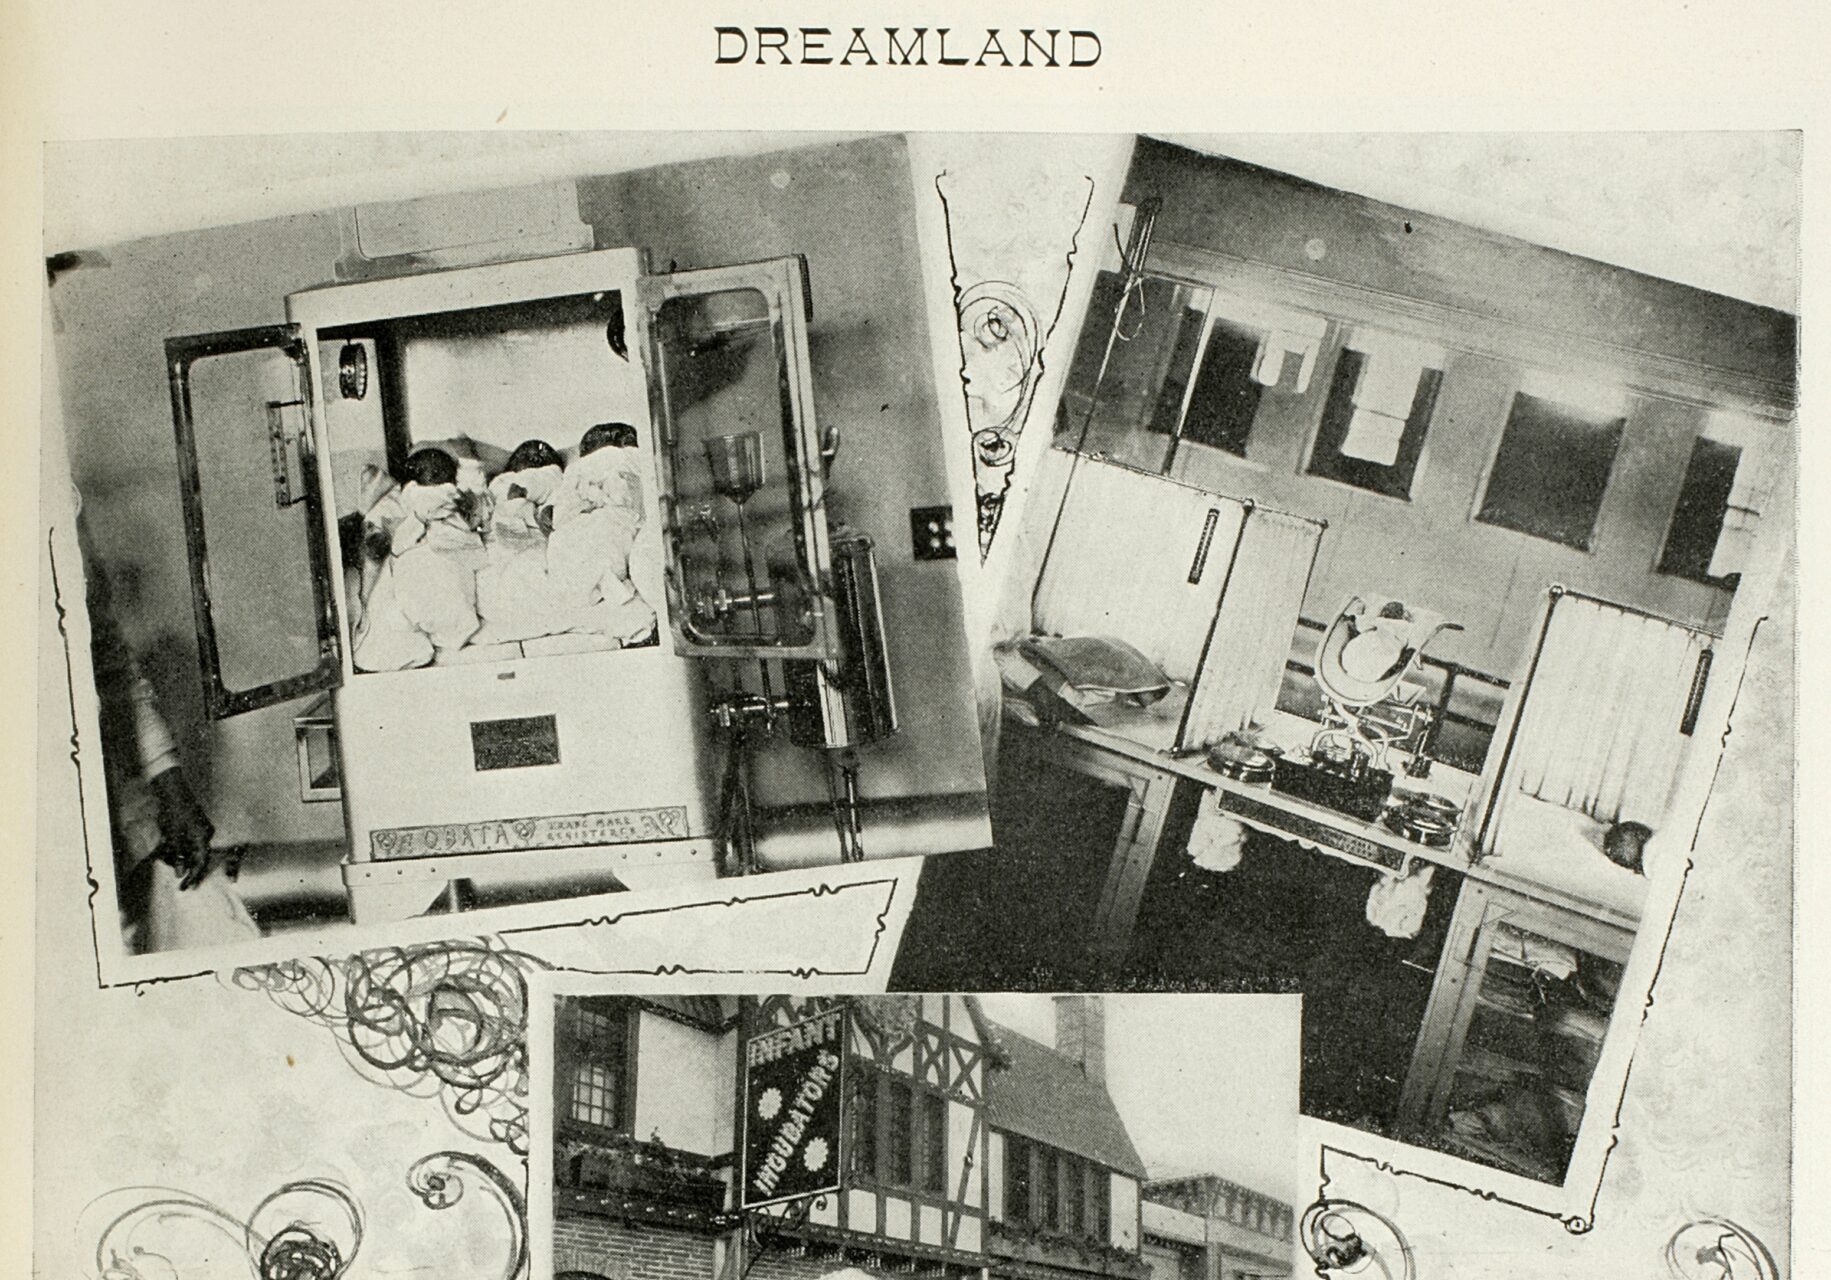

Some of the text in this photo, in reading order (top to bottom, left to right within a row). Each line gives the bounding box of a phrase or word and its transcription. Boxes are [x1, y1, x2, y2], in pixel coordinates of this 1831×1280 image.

[714, 26, 1102, 67] DREAMLAND
[749, 1013, 841, 1067] INFANT
[752, 1048, 841, 1197] INCUBATORS
